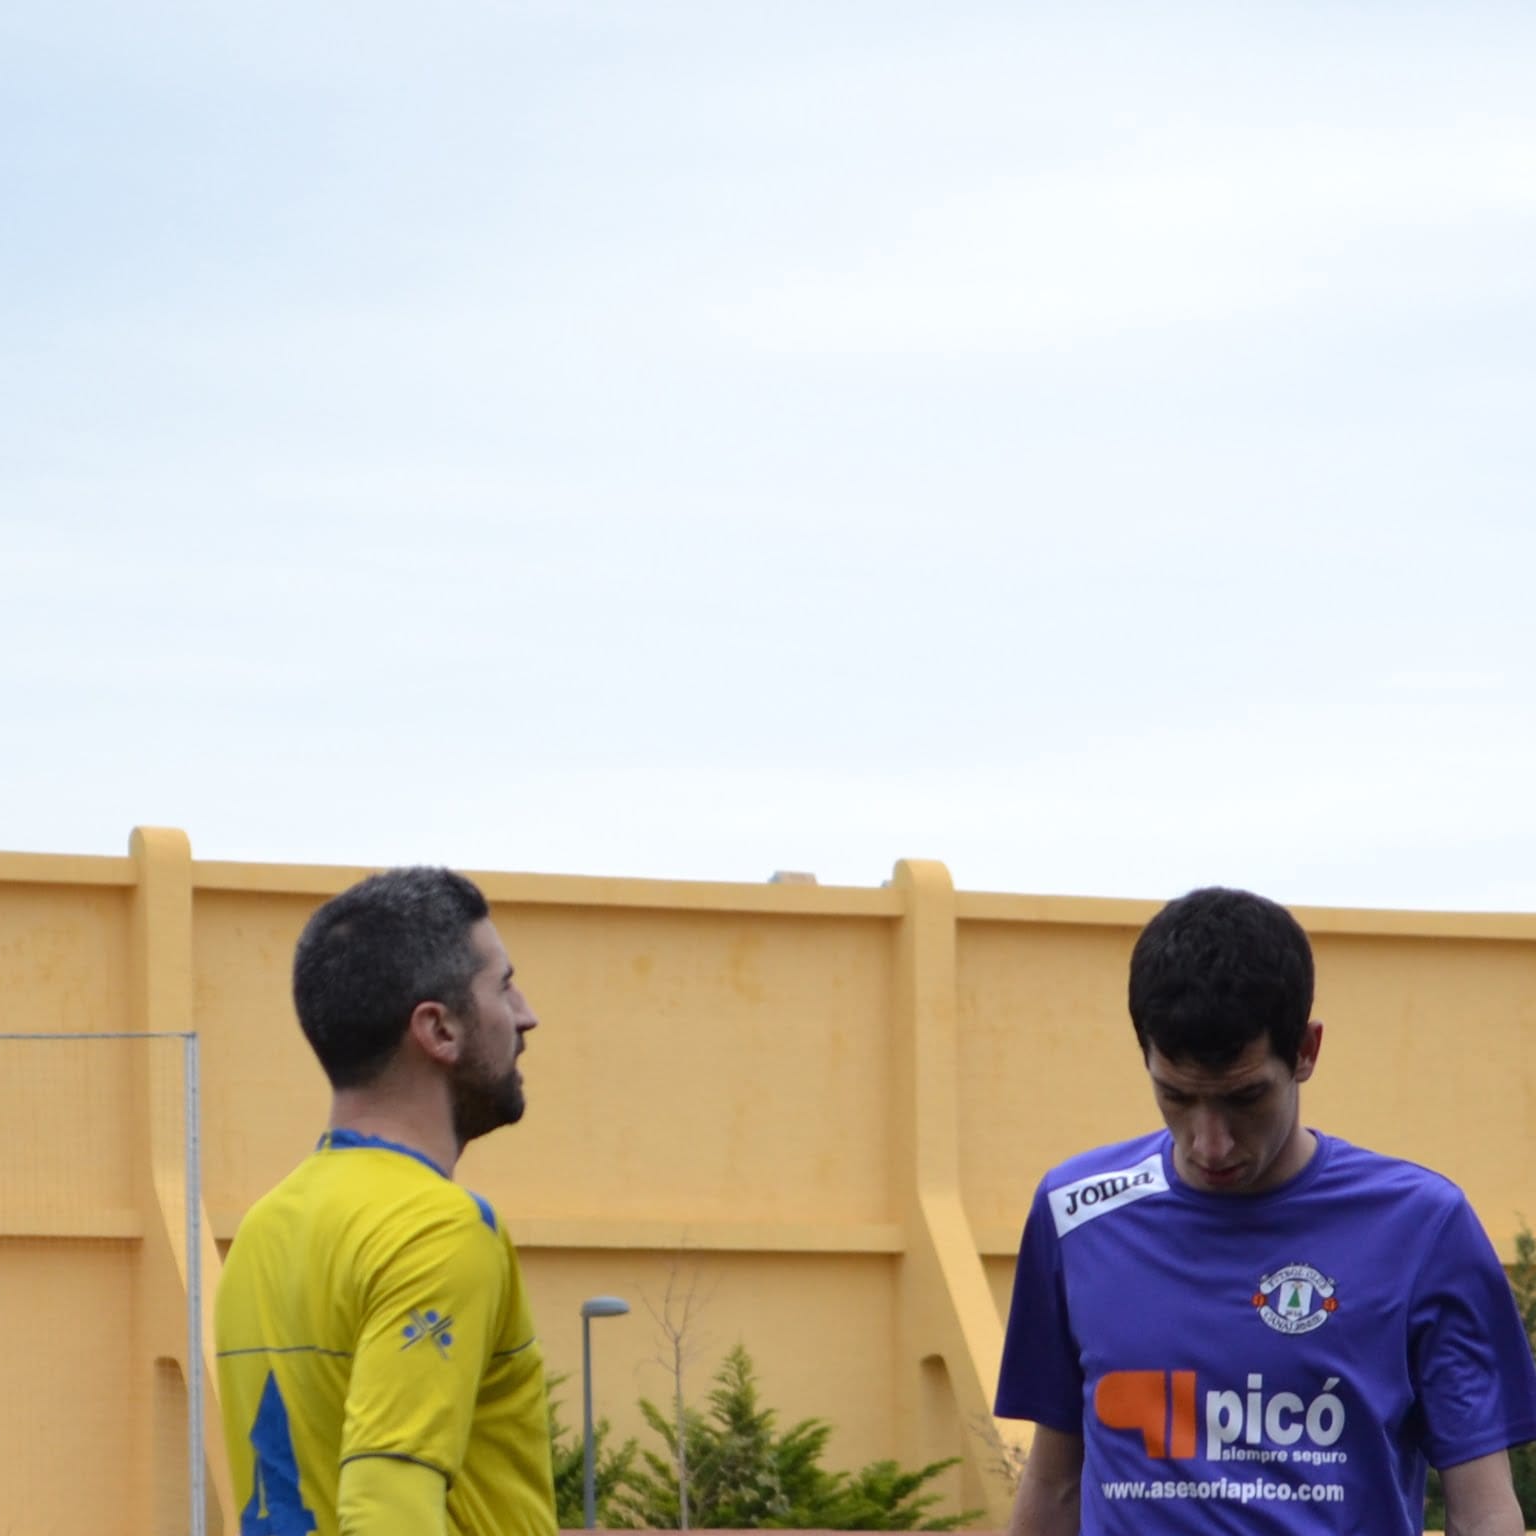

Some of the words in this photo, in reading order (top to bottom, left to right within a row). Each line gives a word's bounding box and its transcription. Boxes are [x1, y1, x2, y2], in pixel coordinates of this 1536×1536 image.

[1206, 1373, 1346, 1461] picó
[1221, 1447, 1288, 1464] siempre
[1292, 1448, 1347, 1466] seguro
[1102, 1477, 1345, 1505] www.asesoriapico.com
